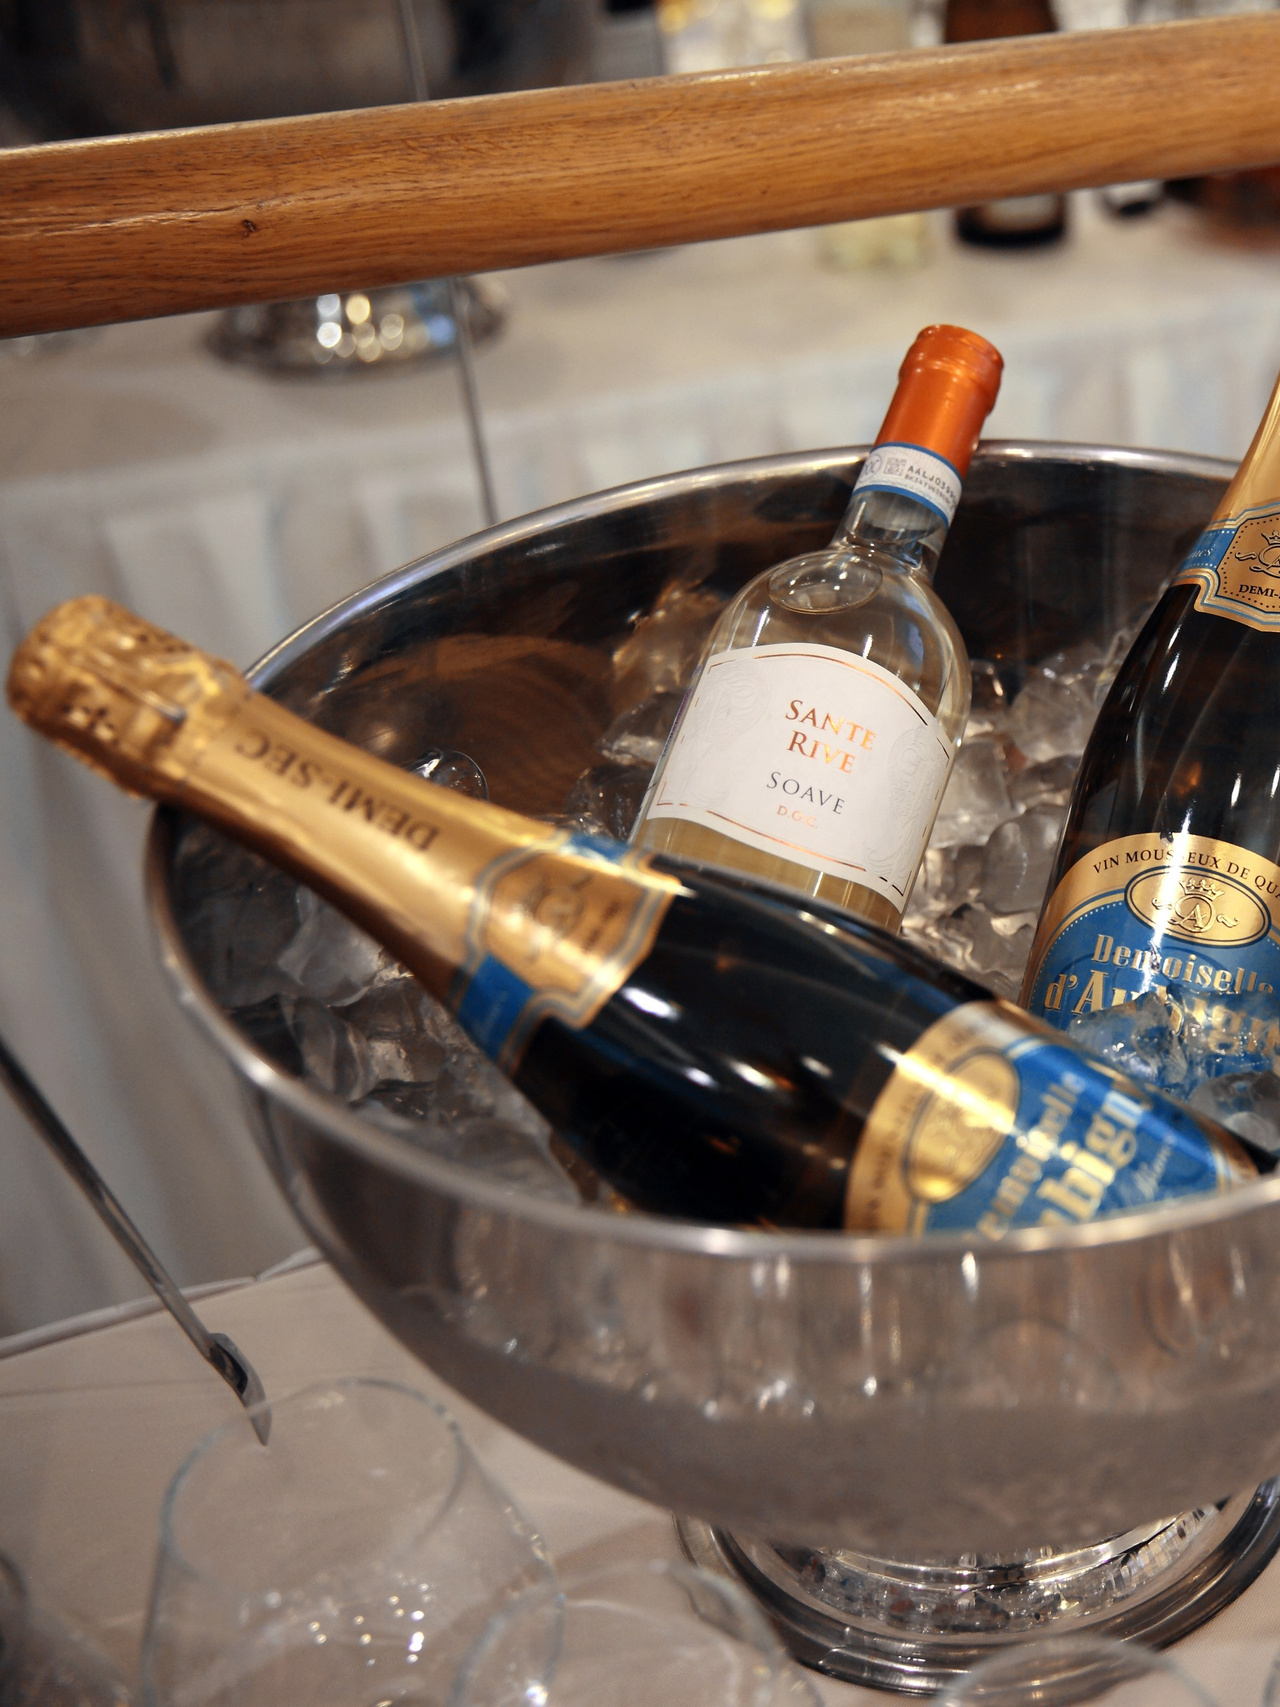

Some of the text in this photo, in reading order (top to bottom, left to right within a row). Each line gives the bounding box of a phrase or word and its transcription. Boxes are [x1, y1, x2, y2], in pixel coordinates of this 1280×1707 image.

[785, 699, 877, 751] SANTE
[786, 730, 856, 774] RIVE
[236, 728, 441, 853] DEMI-SEC
[766, 771, 846, 815] SOAVE
[1093, 855, 1120, 875] VIN
[1125, 849, 1221, 869] MOUSEUX
[1227, 861, 1250, 880] DE
